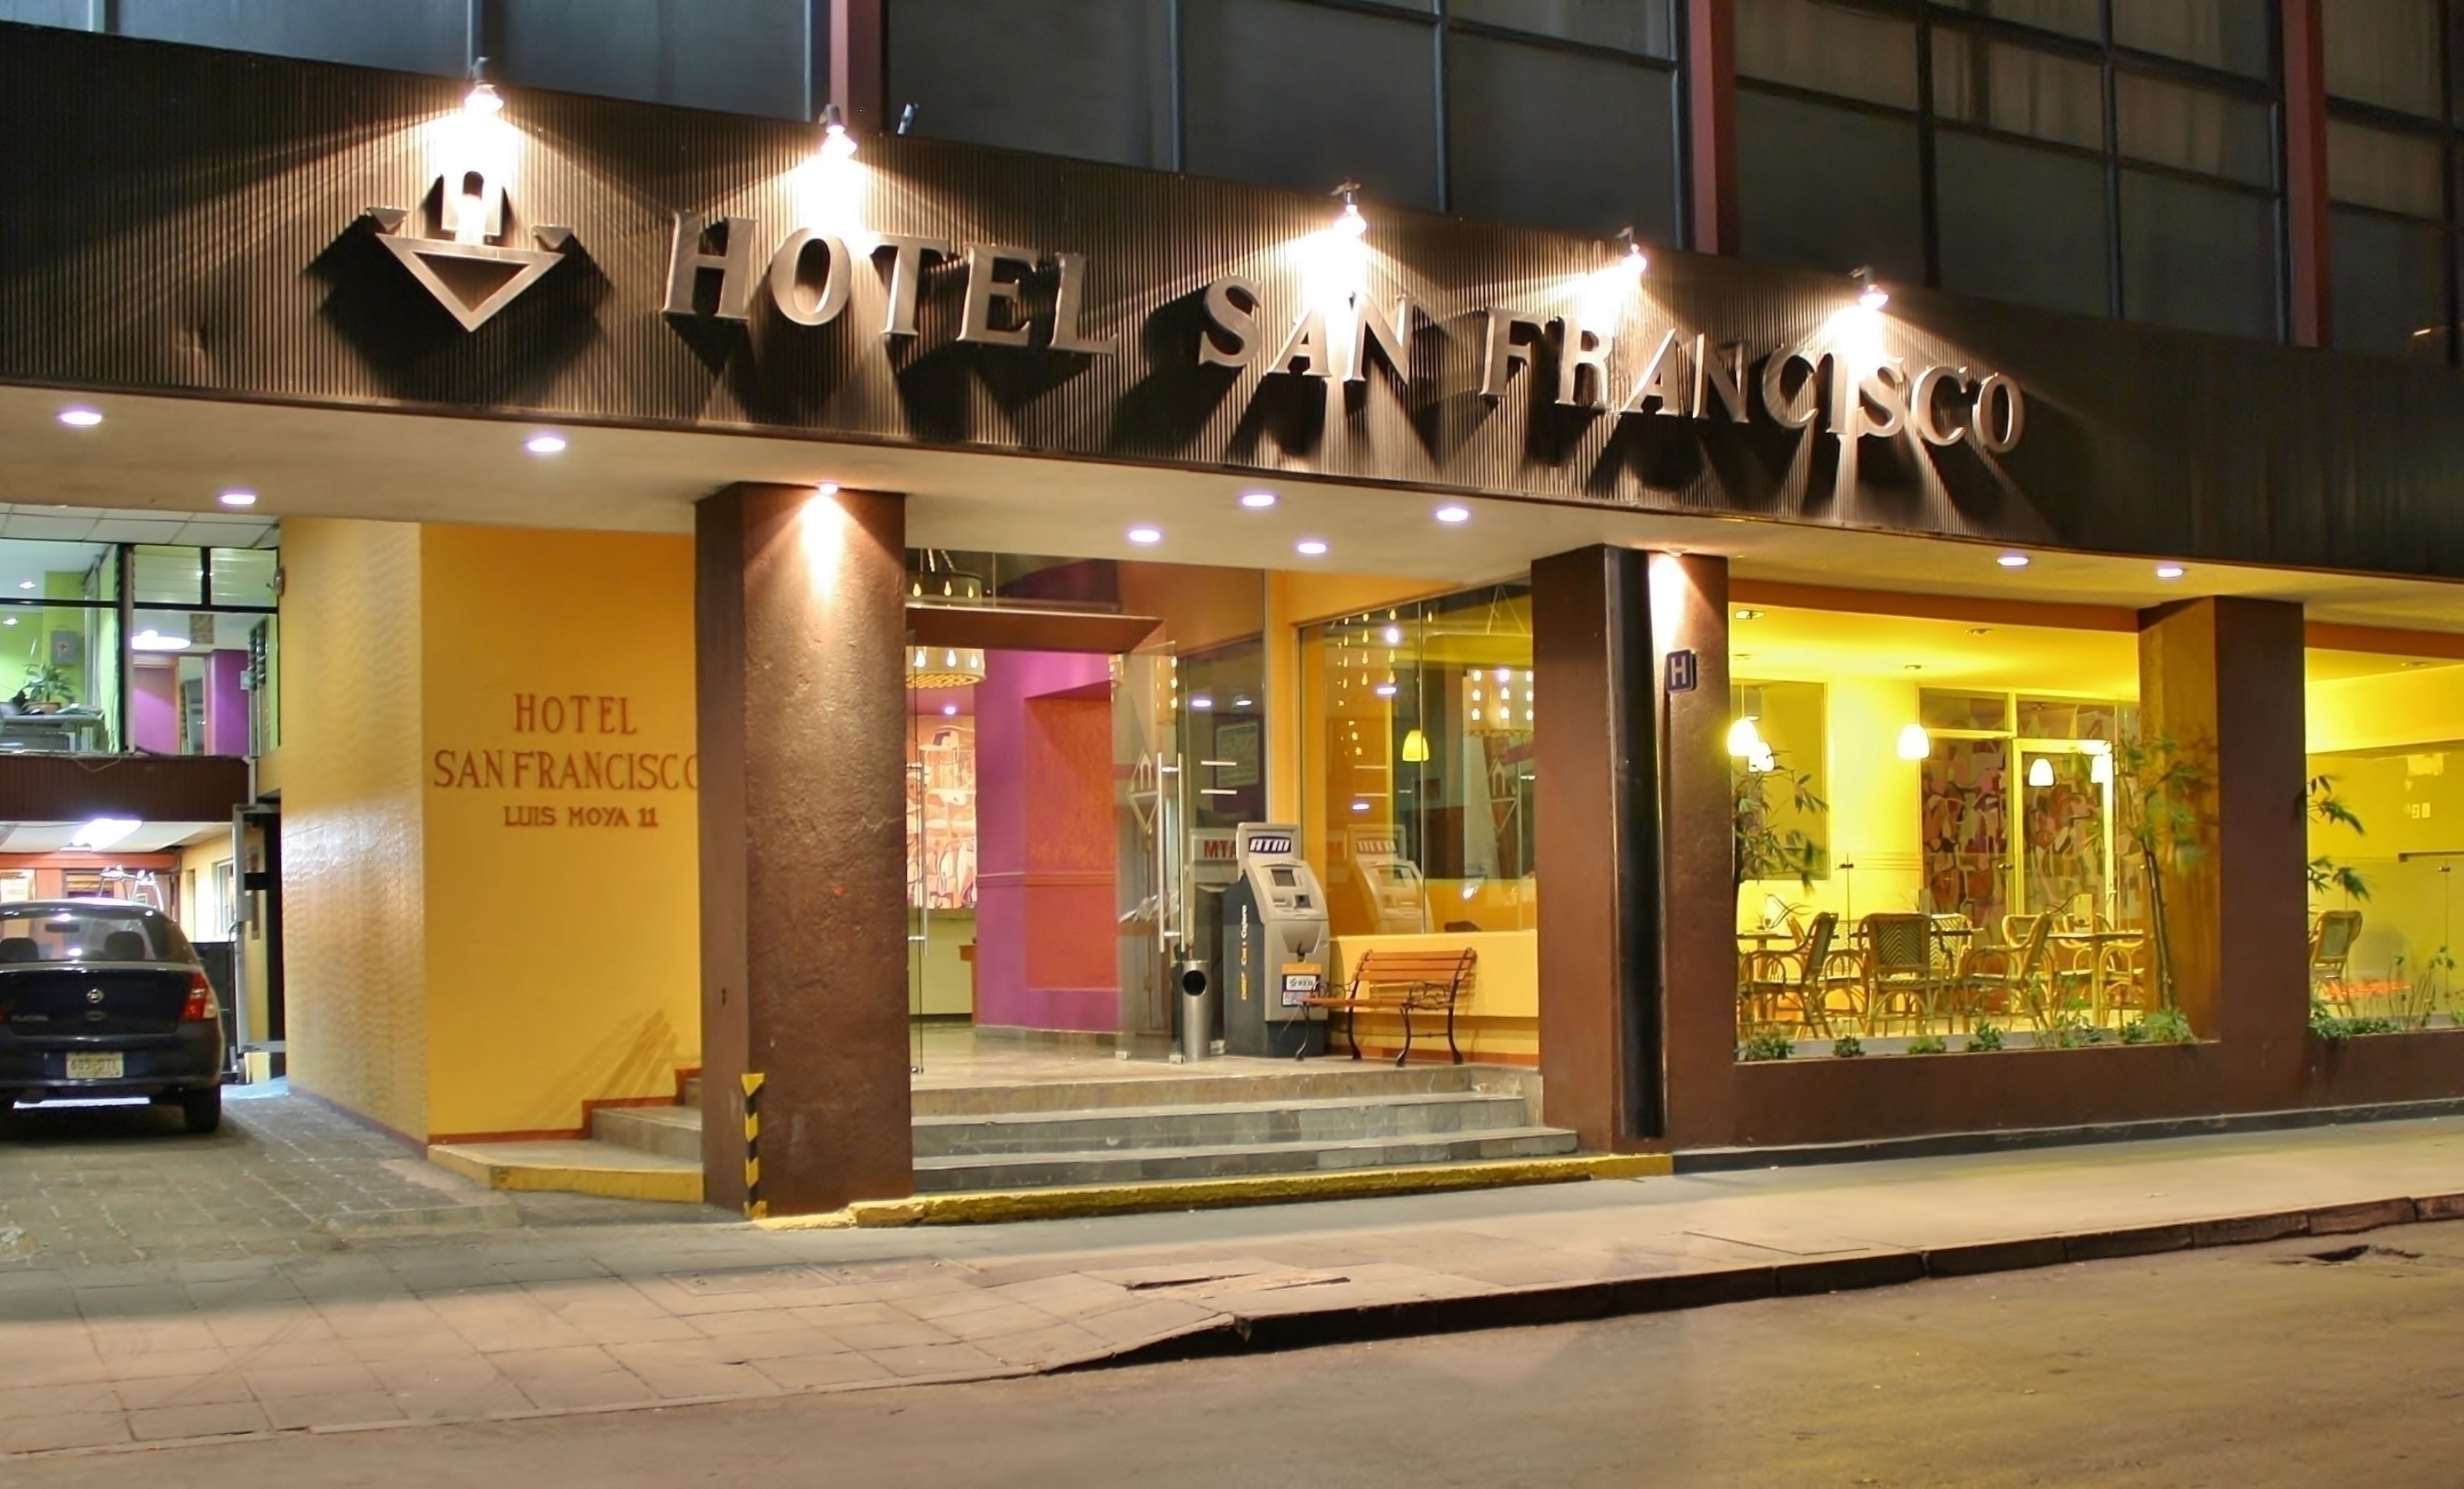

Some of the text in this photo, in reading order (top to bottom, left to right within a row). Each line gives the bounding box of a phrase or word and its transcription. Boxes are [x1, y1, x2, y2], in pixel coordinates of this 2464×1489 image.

[661, 209, 2025, 454] HOTEL SAN FRANCISCO
[1670, 655, 1687, 687] H
[513, 693, 637, 735] HOTEL
[433, 749, 504, 789] SAN
[503, 805, 659, 827] LUIS MOYA 11
[1249, 838, 1290, 852] ATM
